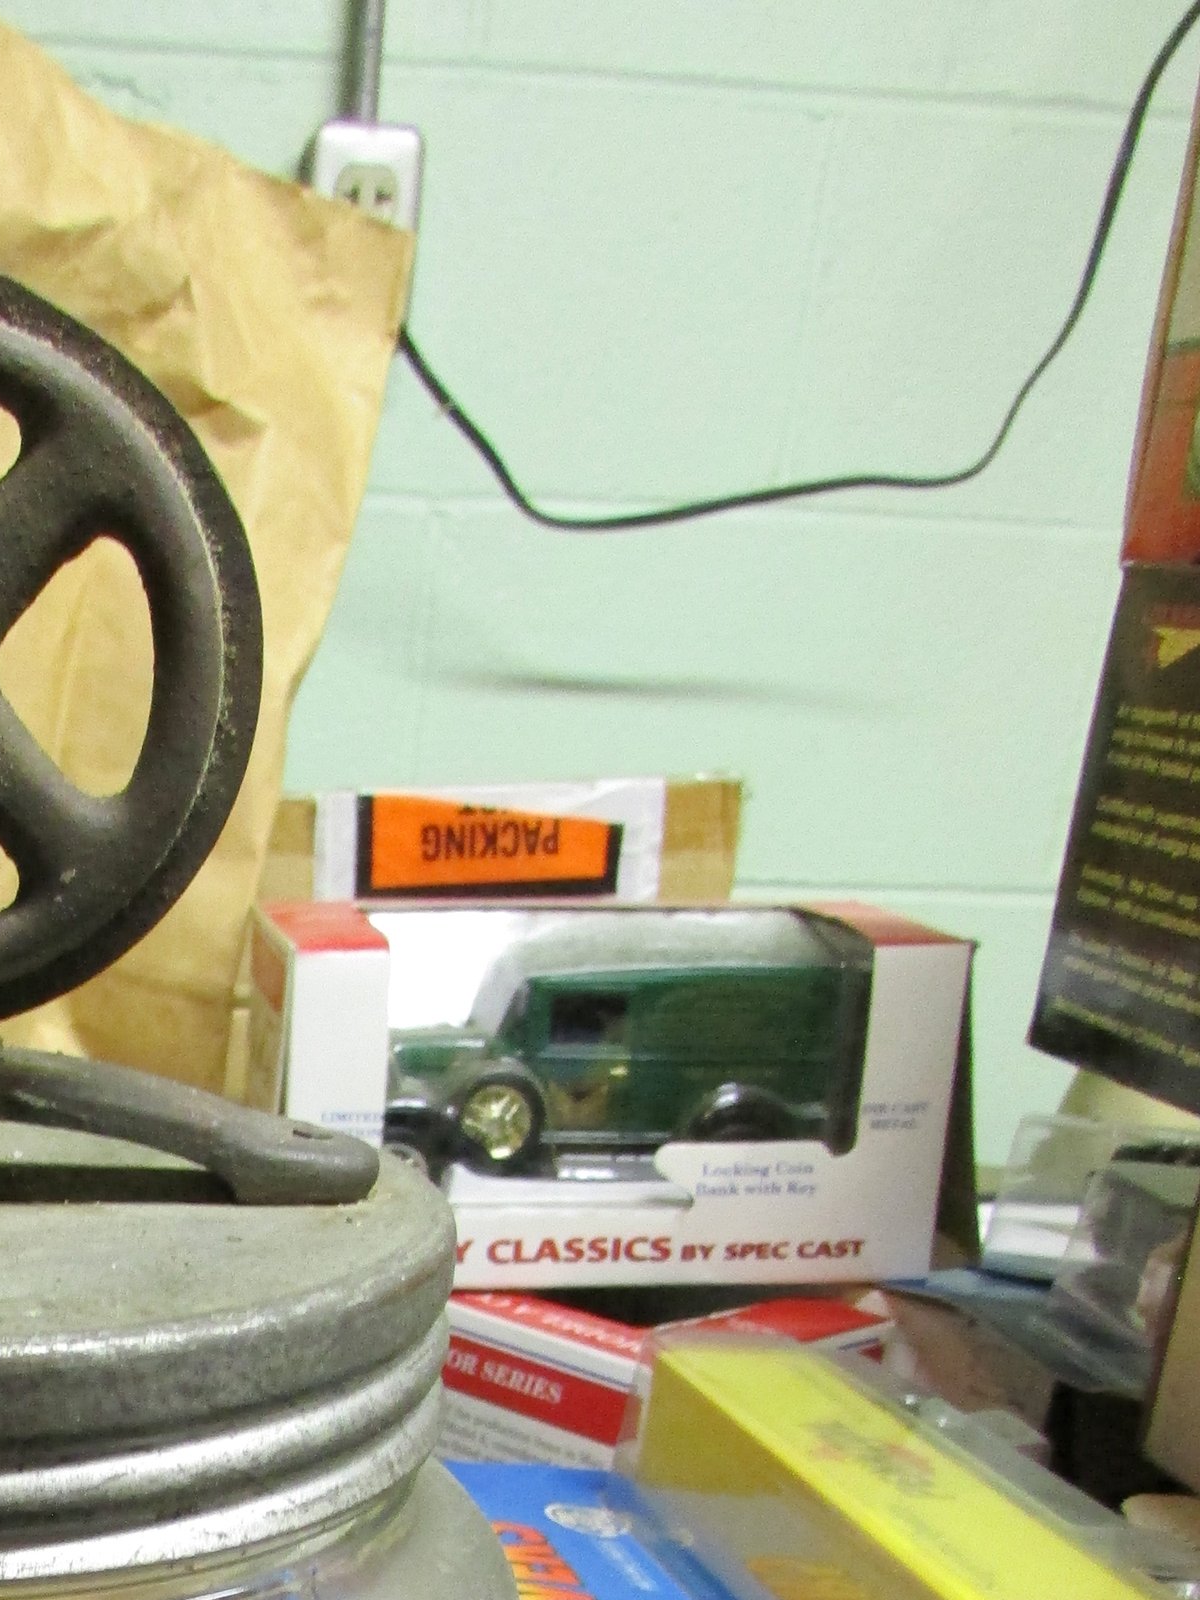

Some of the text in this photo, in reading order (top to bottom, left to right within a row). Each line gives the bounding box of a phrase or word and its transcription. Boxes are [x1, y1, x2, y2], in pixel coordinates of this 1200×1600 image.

[420, 816, 561, 862] PACKING
[486, 1236, 672, 1265] CLASSICS
[680, 1243, 716, 1262] BY
[722, 1241, 791, 1262] SPEC
[795, 1239, 866, 1260] CAST
[449, 1348, 564, 1404] OR SERIES
